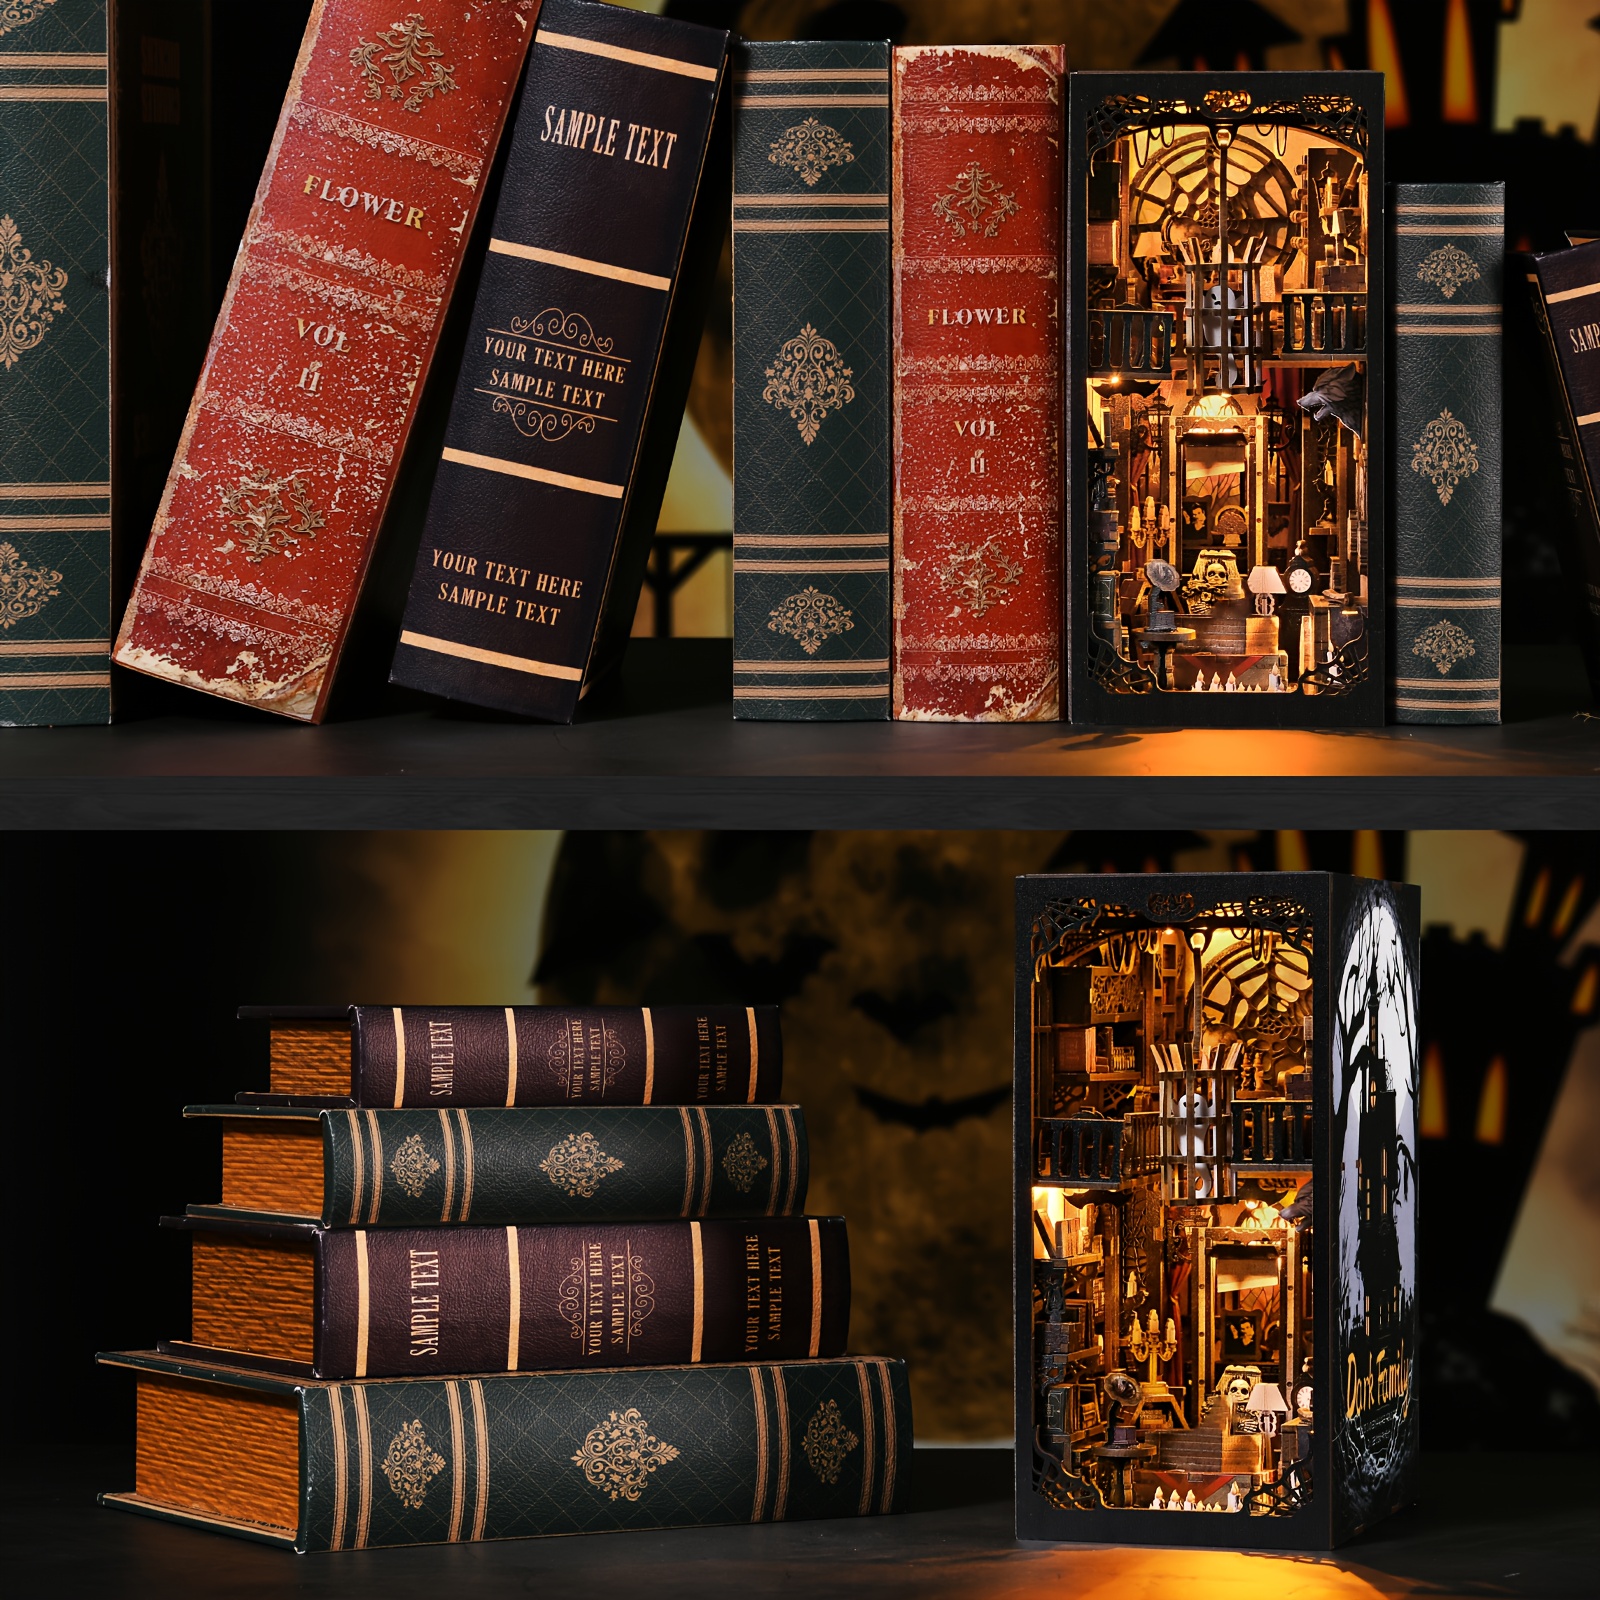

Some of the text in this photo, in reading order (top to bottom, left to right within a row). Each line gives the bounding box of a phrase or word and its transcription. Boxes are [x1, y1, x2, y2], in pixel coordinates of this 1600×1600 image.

[540, 105, 678, 170] SAMPLE TEXT
[303, 174, 425, 230] FLOWER
[296, 317, 351, 354] VOL
[927, 308, 1027, 326] FLOWER
[1569, 321, 1600, 353] SAMP
[483, 336, 626, 384] YOUR TEXT HERE
[489, 368, 606, 409] SAMPLE TEXT
[954, 419, 1002, 437] VOL
[432, 548, 583, 599] YOUR TEXT HERE
[438, 582, 561, 626] SAMPLE TEXT
[429, 1021, 454, 1096] SAMPLE TEXT
[571, 1019, 584, 1099] YOUR TEXT HERE
[589, 1027, 601, 1091] SAMPLE TEXT
[697, 1016, 710, 1099] YOUR TEXT HERE
[716, 1024, 728, 1091] SAMPLE TEXT
[410, 1250, 440, 1356] SAMPLE TEXT
[588, 1242, 603, 1356] YOUR TEXT HERE
[611, 1254, 625, 1344] SAMPLE TEXT
[745, 1234, 760, 1352] YOUR TEXT HERE
[767, 1246, 782, 1341] SAMPLE TEXT
[1345, 1338, 1410, 1419] Dark Family
